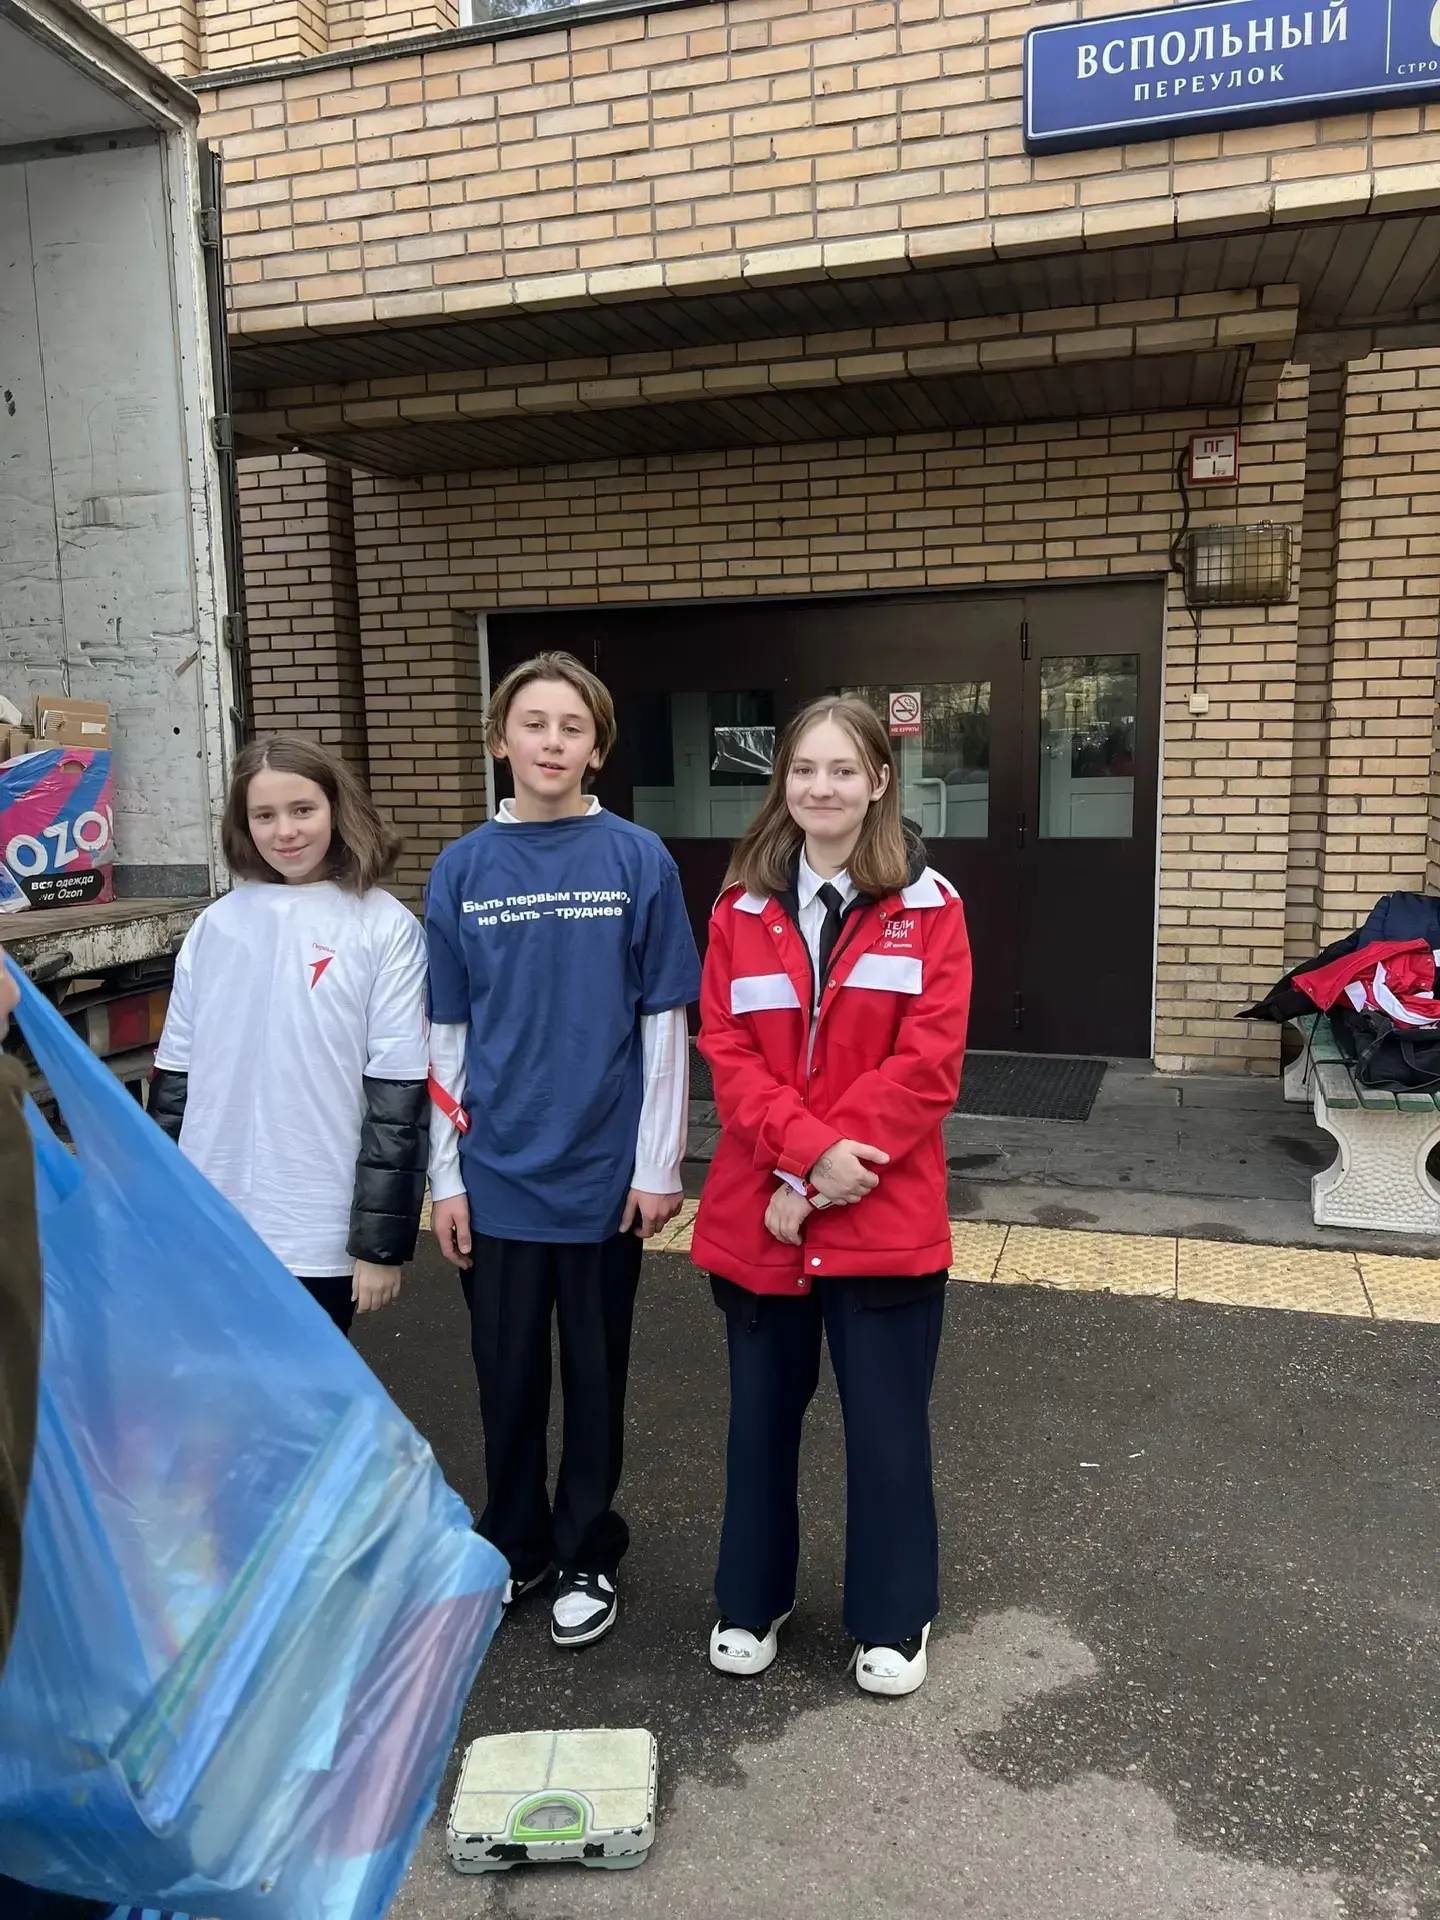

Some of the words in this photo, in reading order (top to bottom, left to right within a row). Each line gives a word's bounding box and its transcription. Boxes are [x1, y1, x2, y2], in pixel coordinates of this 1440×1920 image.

[1076, 0, 1349, 80] ВСПОЛЬНЫЙ
[1133, 63, 1285, 101] ПЕРЕУЛОК
[1204, 439, 1225, 453] ПГ
[55, 875, 95, 889] одежда
[57, 888, 84, 900] Ozon
[462, 894, 504, 914] Быть
[506, 890, 570, 907] первым
[572, 890, 632, 904] трудно,
[477, 914, 498, 926] не
[500, 909, 541, 924] быть
[554, 905, 623, 919] труднее
[885, 919, 915, 930] ТЕЛИ
